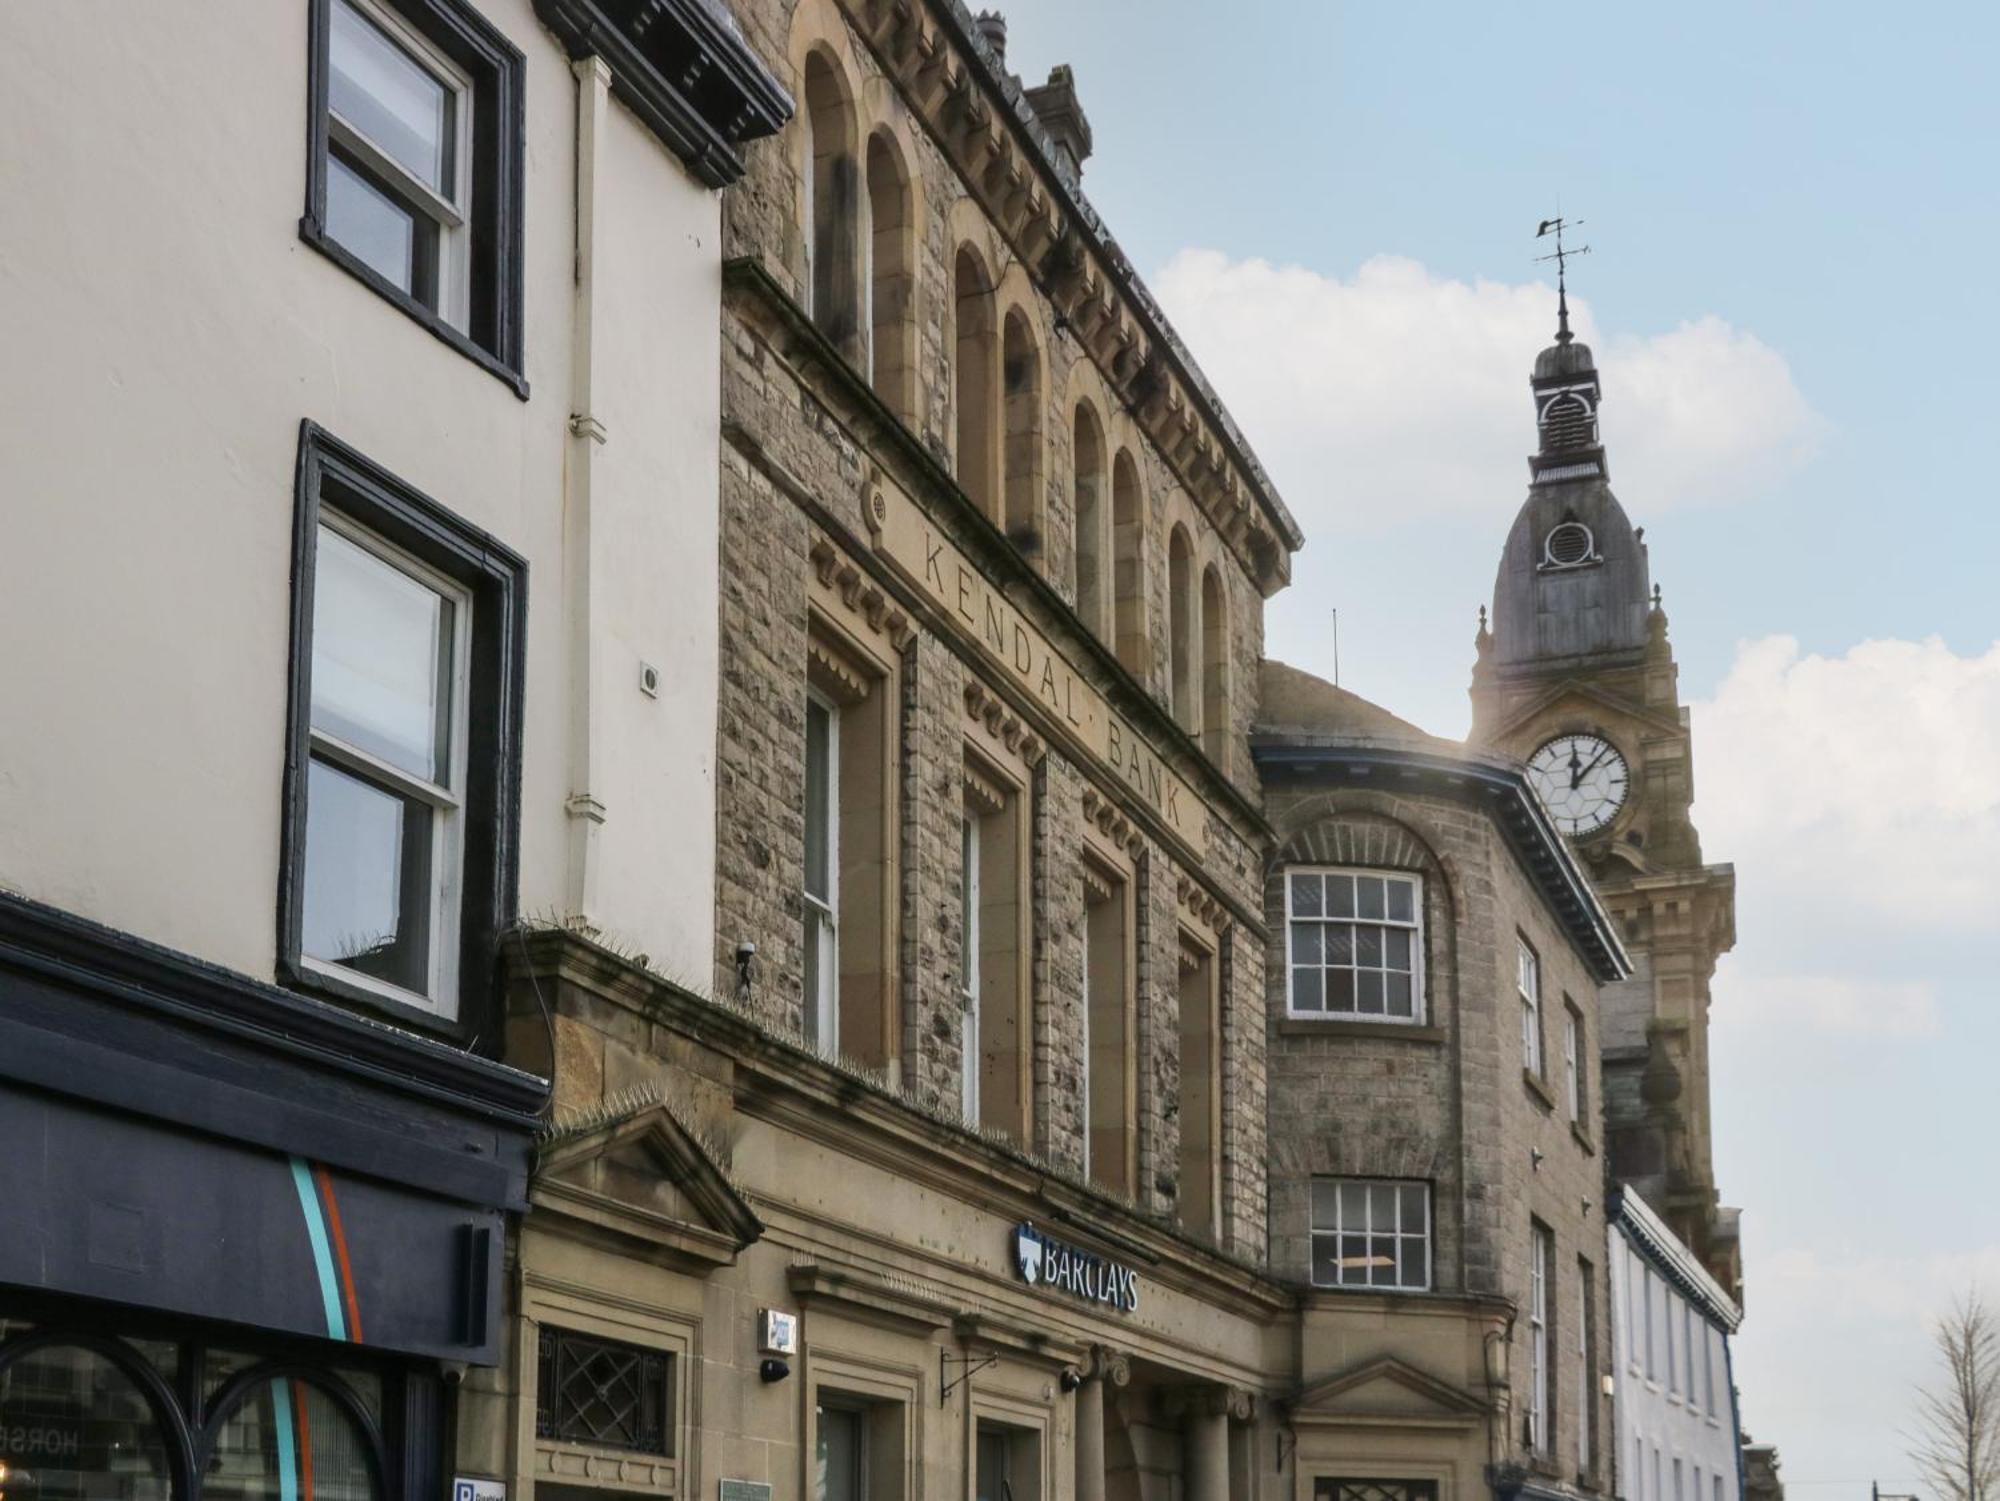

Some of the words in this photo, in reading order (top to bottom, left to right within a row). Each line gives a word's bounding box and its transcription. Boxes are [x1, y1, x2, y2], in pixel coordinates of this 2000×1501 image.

[925, 531, 1080, 728] KENDAL
[1107, 719, 1180, 827] BANK
[1045, 1247, 1137, 1312] BARCLAYS
